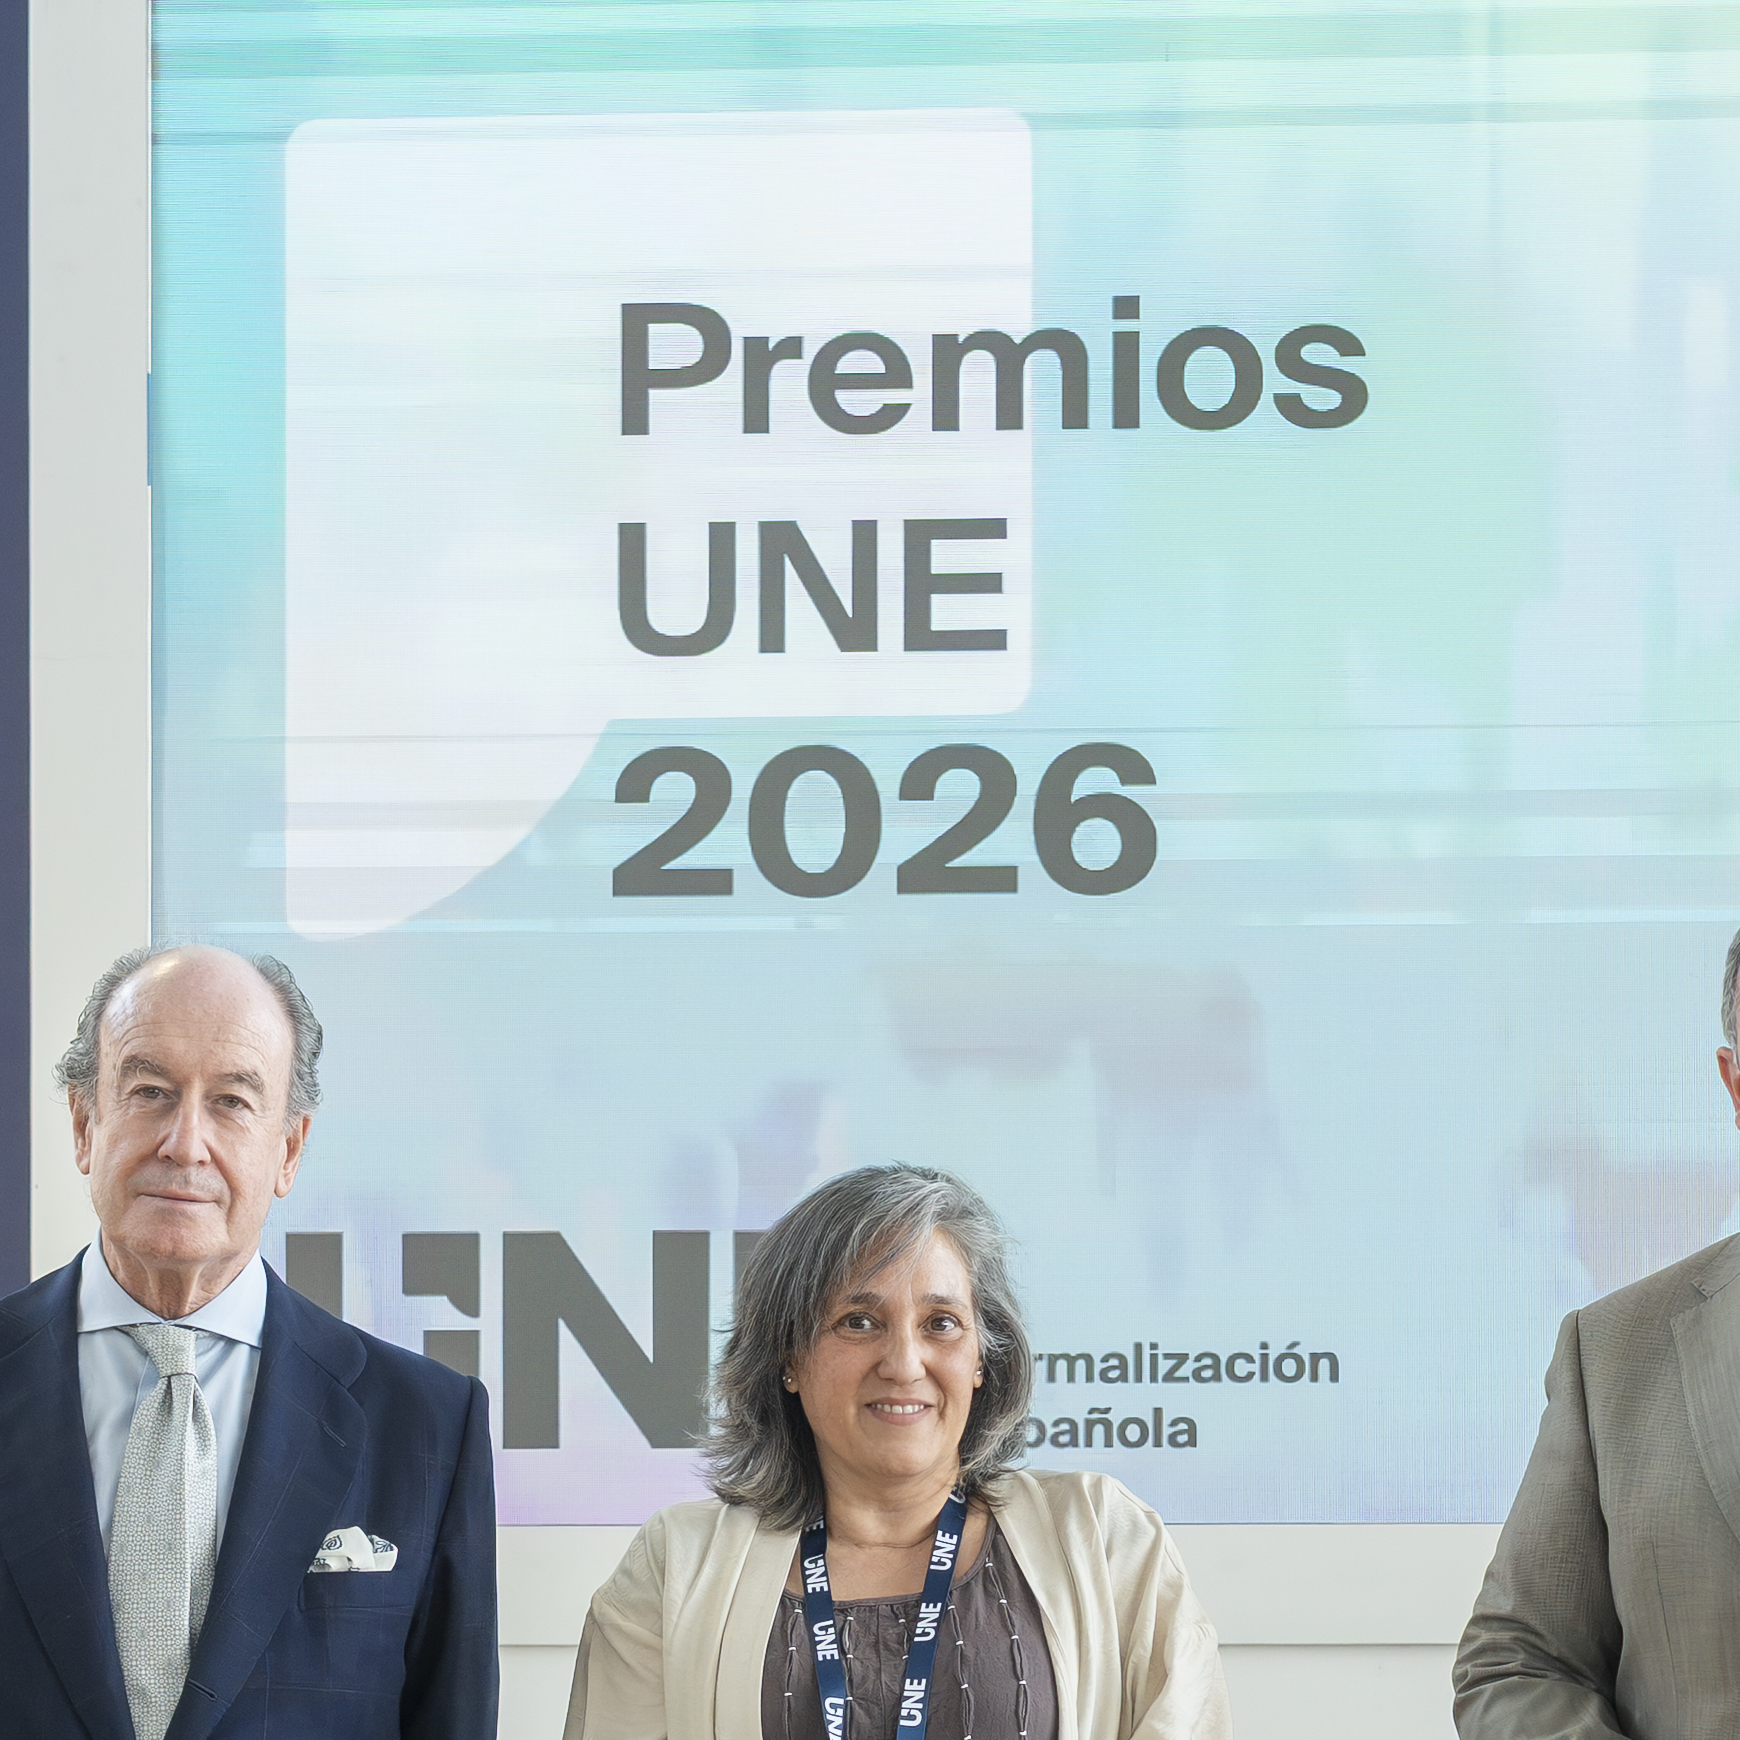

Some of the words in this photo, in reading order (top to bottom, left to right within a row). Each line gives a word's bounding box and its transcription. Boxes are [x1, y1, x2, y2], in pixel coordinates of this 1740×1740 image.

[620, 294, 1369, 436] Premios
[617, 517, 1008, 658] UNE
[612, 741, 1158, 899] 2026
[1035, 1341, 1340, 1384] malización
[929, 1529, 958, 1571] UNE
[803, 1553, 829, 1594] UNE
[812, 1619, 840, 1662] UNE
[913, 1602, 943, 1642] UNE
[899, 1678, 927, 1728] UNE
